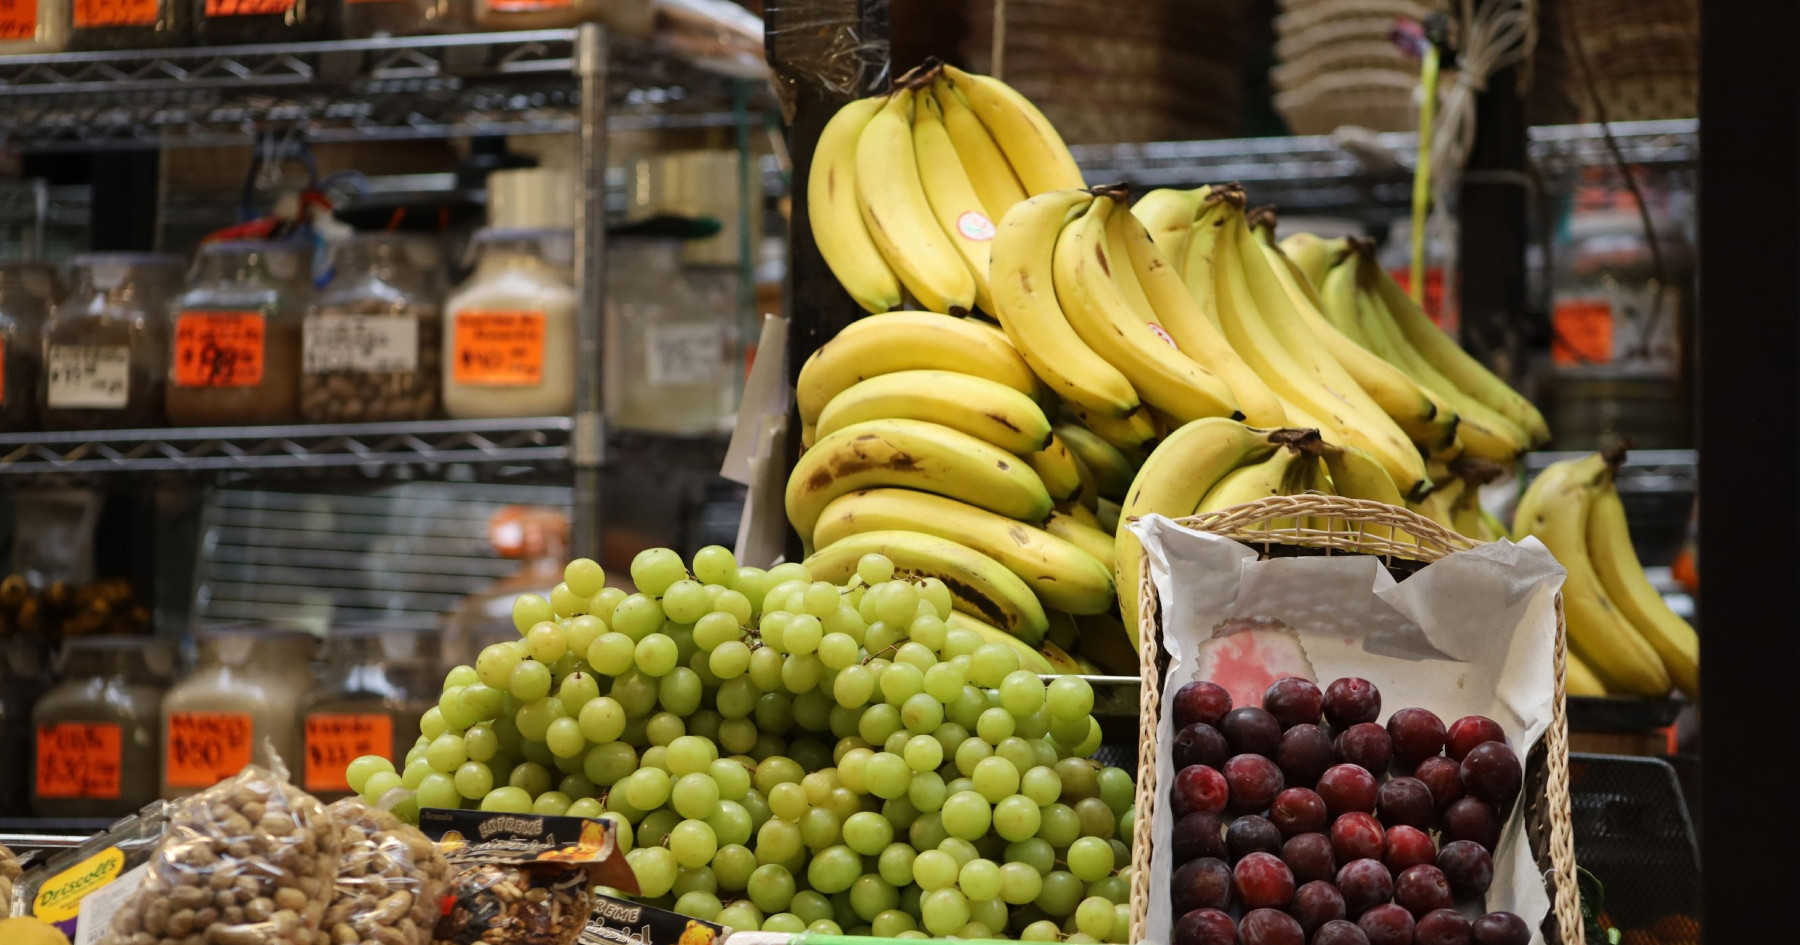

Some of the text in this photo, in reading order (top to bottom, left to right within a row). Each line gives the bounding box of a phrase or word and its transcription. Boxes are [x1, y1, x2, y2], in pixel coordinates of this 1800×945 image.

[478, 815, 544, 839] EXTREME
[40, 857, 117, 907] Driscoll's
[593, 899, 642, 923] REME
